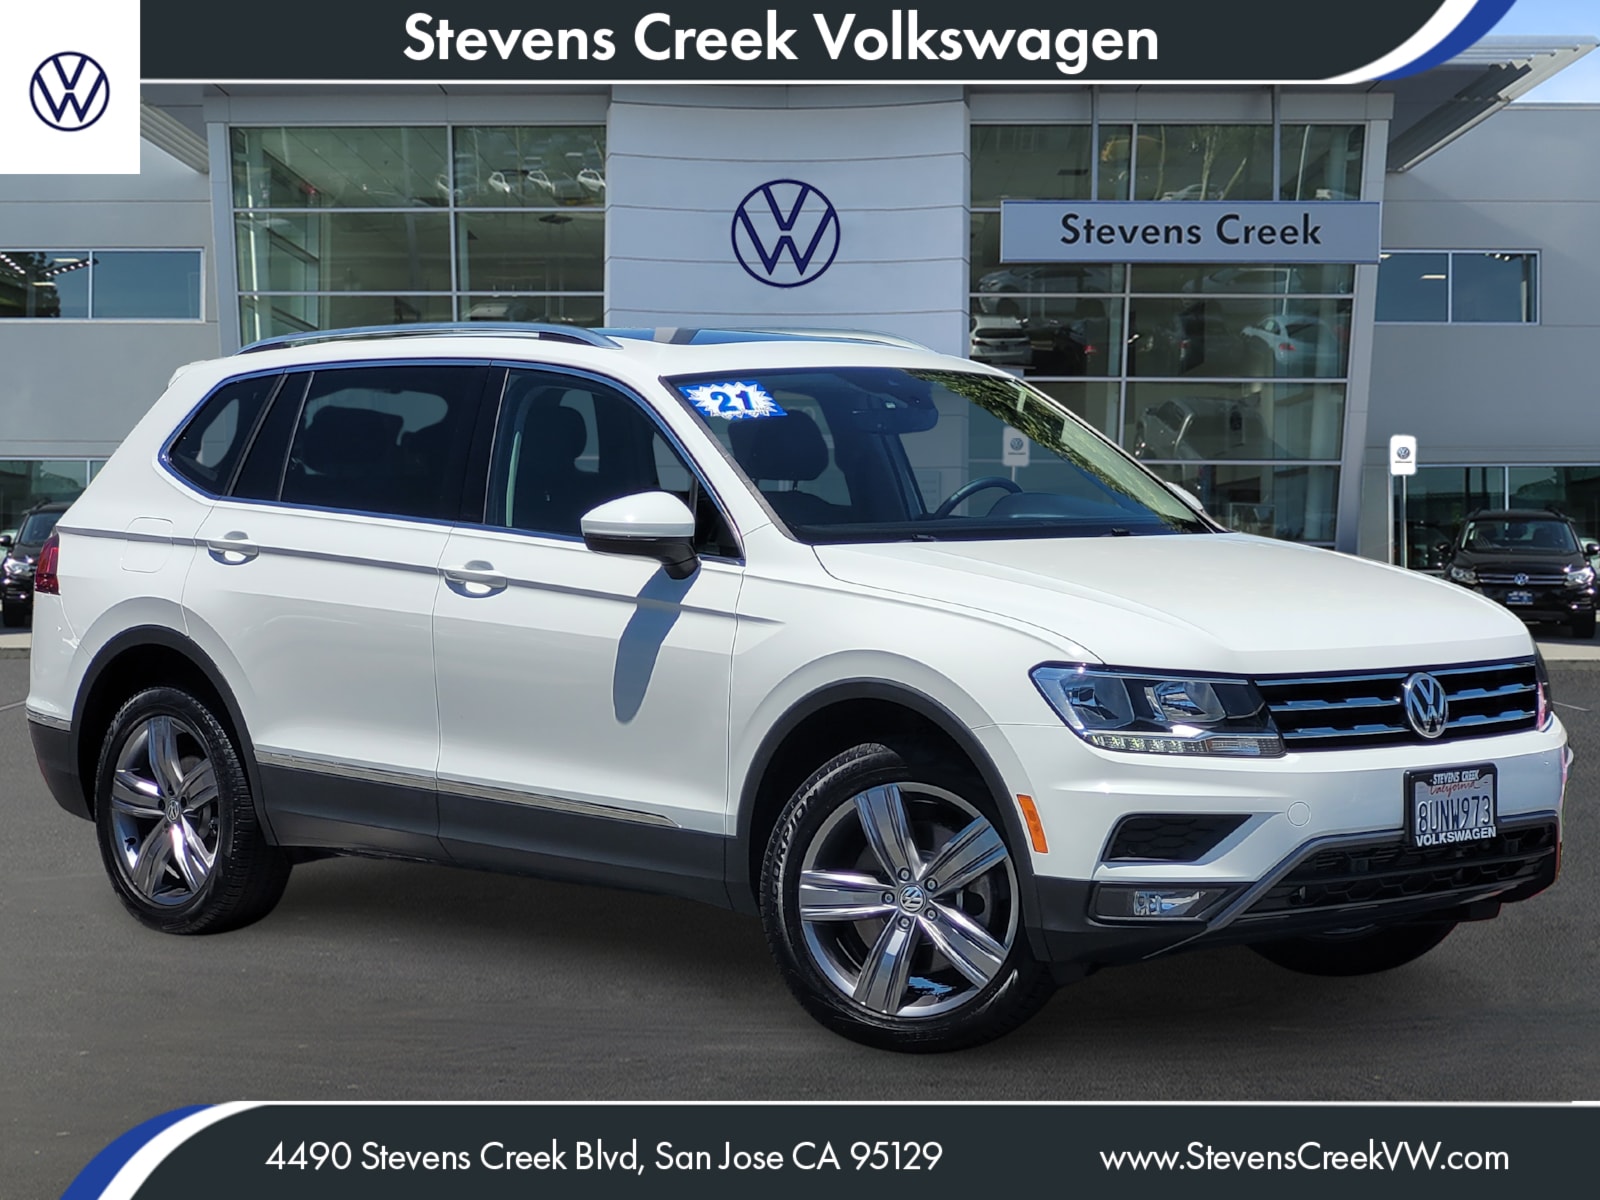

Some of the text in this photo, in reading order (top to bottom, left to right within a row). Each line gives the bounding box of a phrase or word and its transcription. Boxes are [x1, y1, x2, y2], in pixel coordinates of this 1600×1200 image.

[1060, 212, 1321, 245] Stevens Creek
[709, 390, 756, 413] 21
[1432, 769, 1480, 785] STEVENS CREEK
[1417, 795, 1491, 833] 8UNW973
[1415, 826, 1497, 847] VOLKSWAGEN
